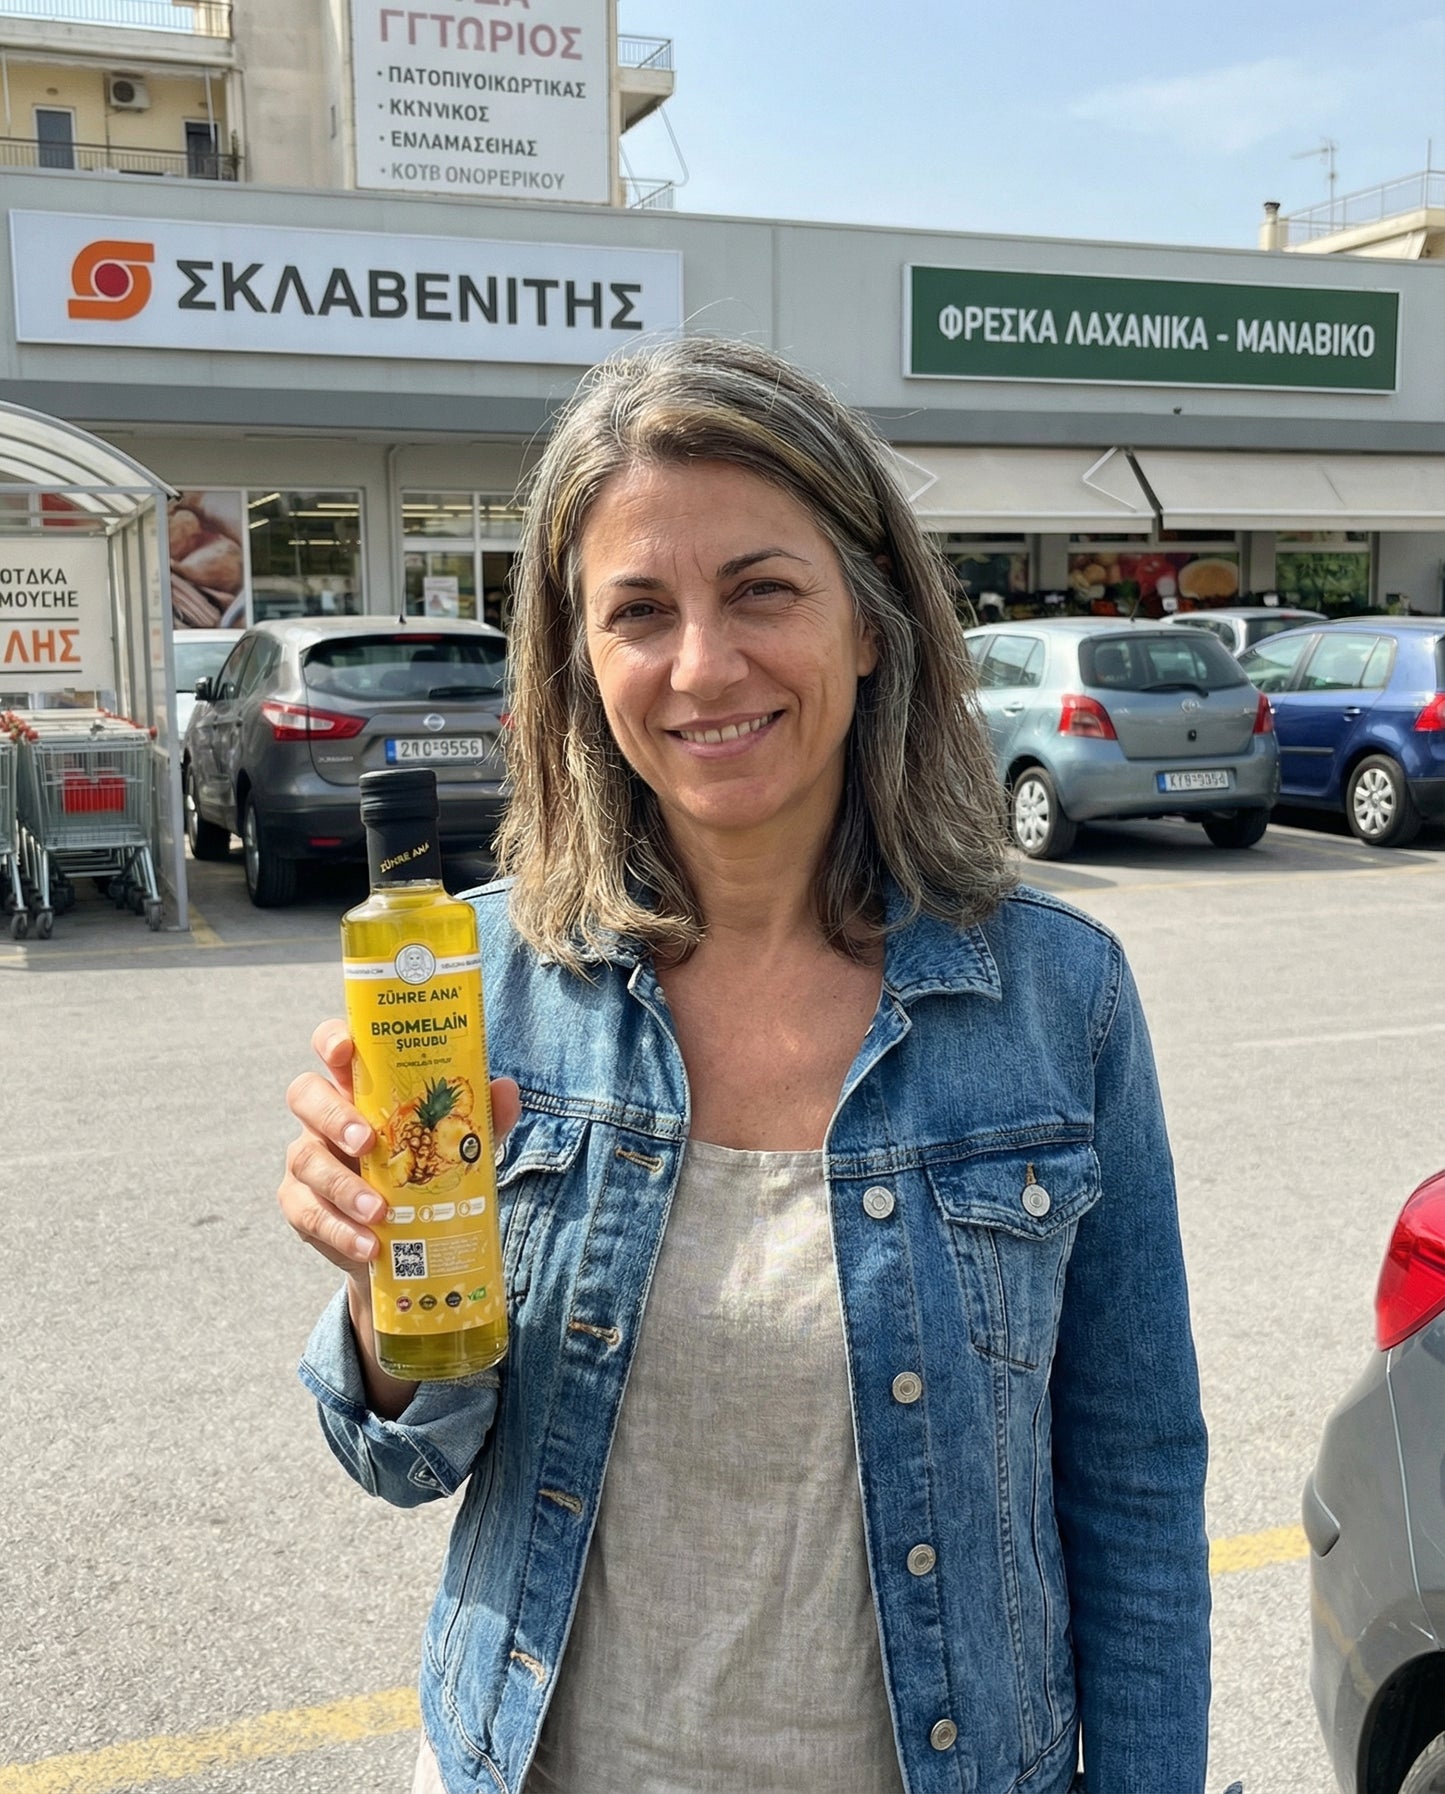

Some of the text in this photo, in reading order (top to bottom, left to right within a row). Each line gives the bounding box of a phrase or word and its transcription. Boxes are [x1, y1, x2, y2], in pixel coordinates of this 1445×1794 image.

[176, 258, 644, 331] ΣΚΛΑΒΕΝΙΤΗΣ
[938, 305, 1058, 345] ΦΡΕΣΚΑ
[1064, 310, 1209, 351] ΛΑΧΑΝΙΚΑ
[1236, 318, 1375, 358] ΜΑΝΑΒΙΚΟ
[4, 629, 81, 663] ΛΗΣ
[396, 1035, 448, 1052] ŞURUBU
